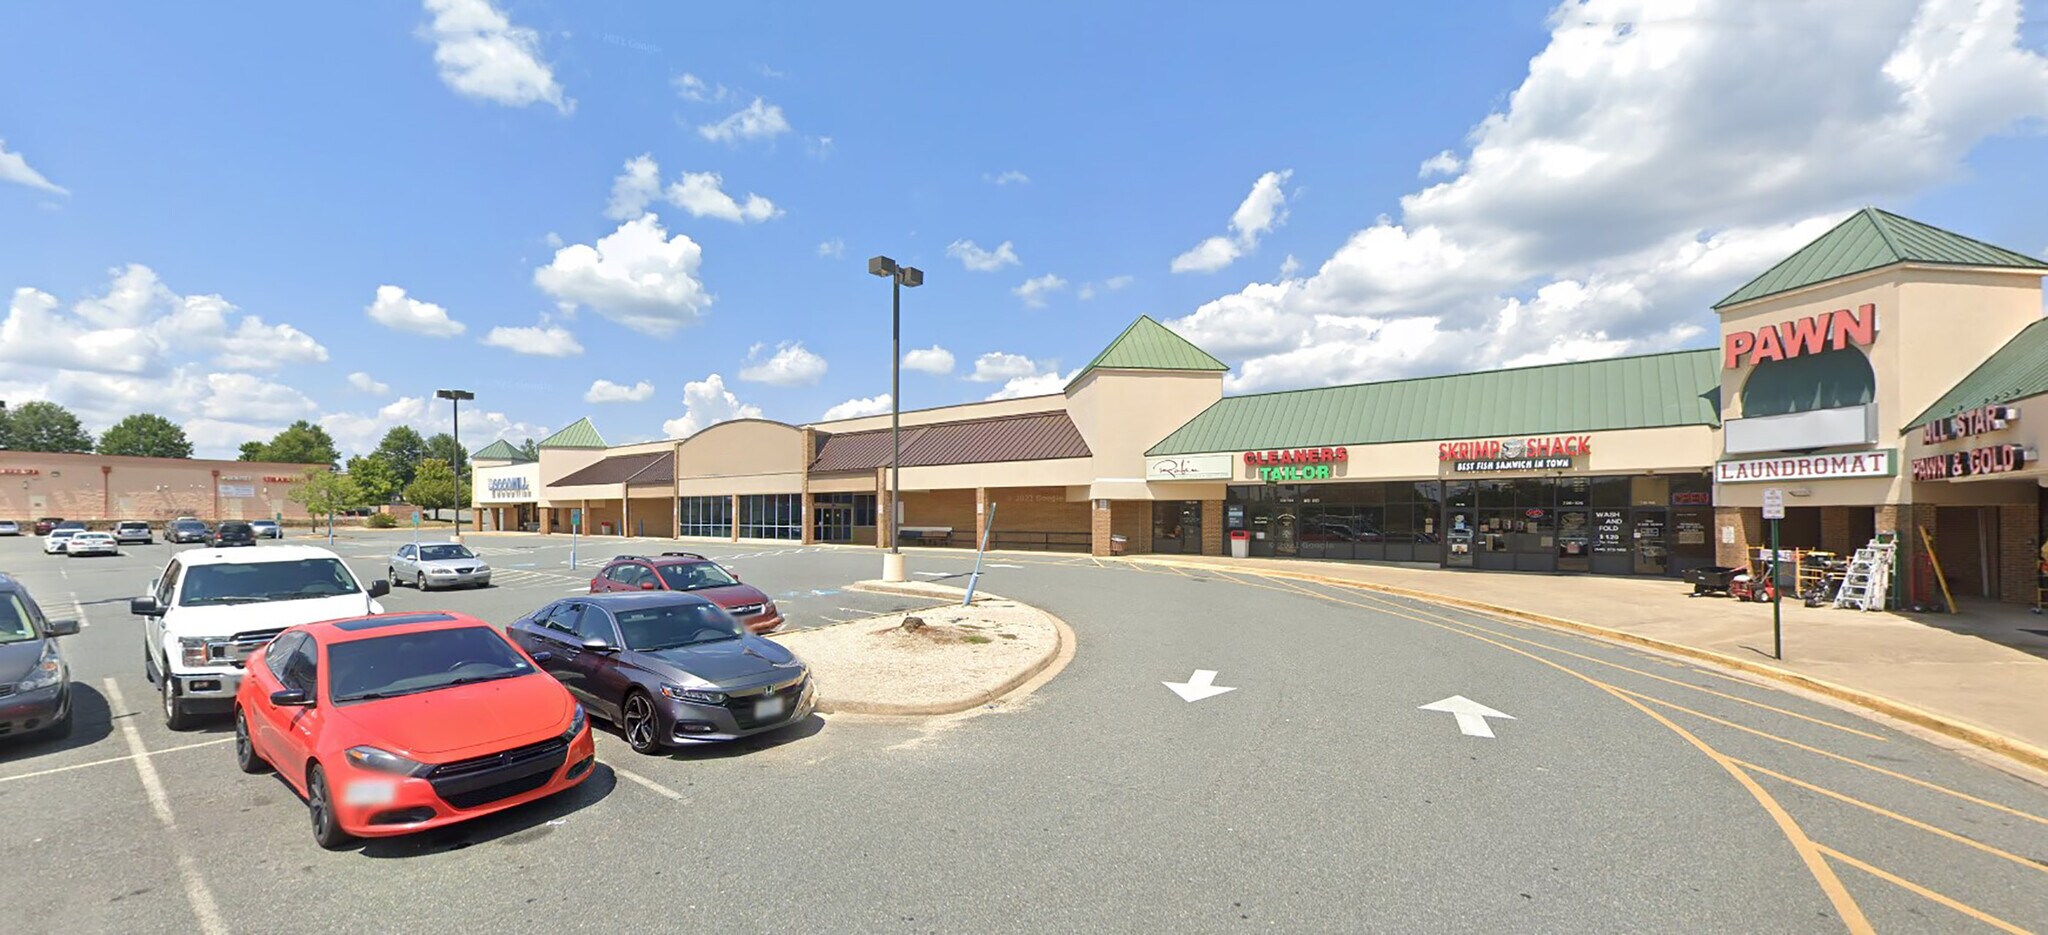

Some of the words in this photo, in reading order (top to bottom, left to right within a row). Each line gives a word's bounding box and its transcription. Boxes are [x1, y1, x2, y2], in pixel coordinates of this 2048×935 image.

[1726, 303, 1875, 369] PAWN
[1923, 419, 1948, 444] ALL
[1956, 404, 1997, 438] STAR
[1243, 447, 1348, 466] CLEANERS
[1439, 440, 1500, 461] SKRIMP
[1527, 436, 1591, 457] SHACK
[1260, 465, 1330, 481] TAILOR
[1457, 463, 1475, 471] BEST
[1476, 462, 1494, 470] FISH
[1534, 459, 1544, 468] IN
[1546, 459, 1569, 468] TOWN
[1721, 454, 1884, 480] LAUNDROMAT
[1912, 454, 1946, 480] PAWN
[1952, 452, 1963, 476] &
[1970, 444, 2014, 475] GOLD
